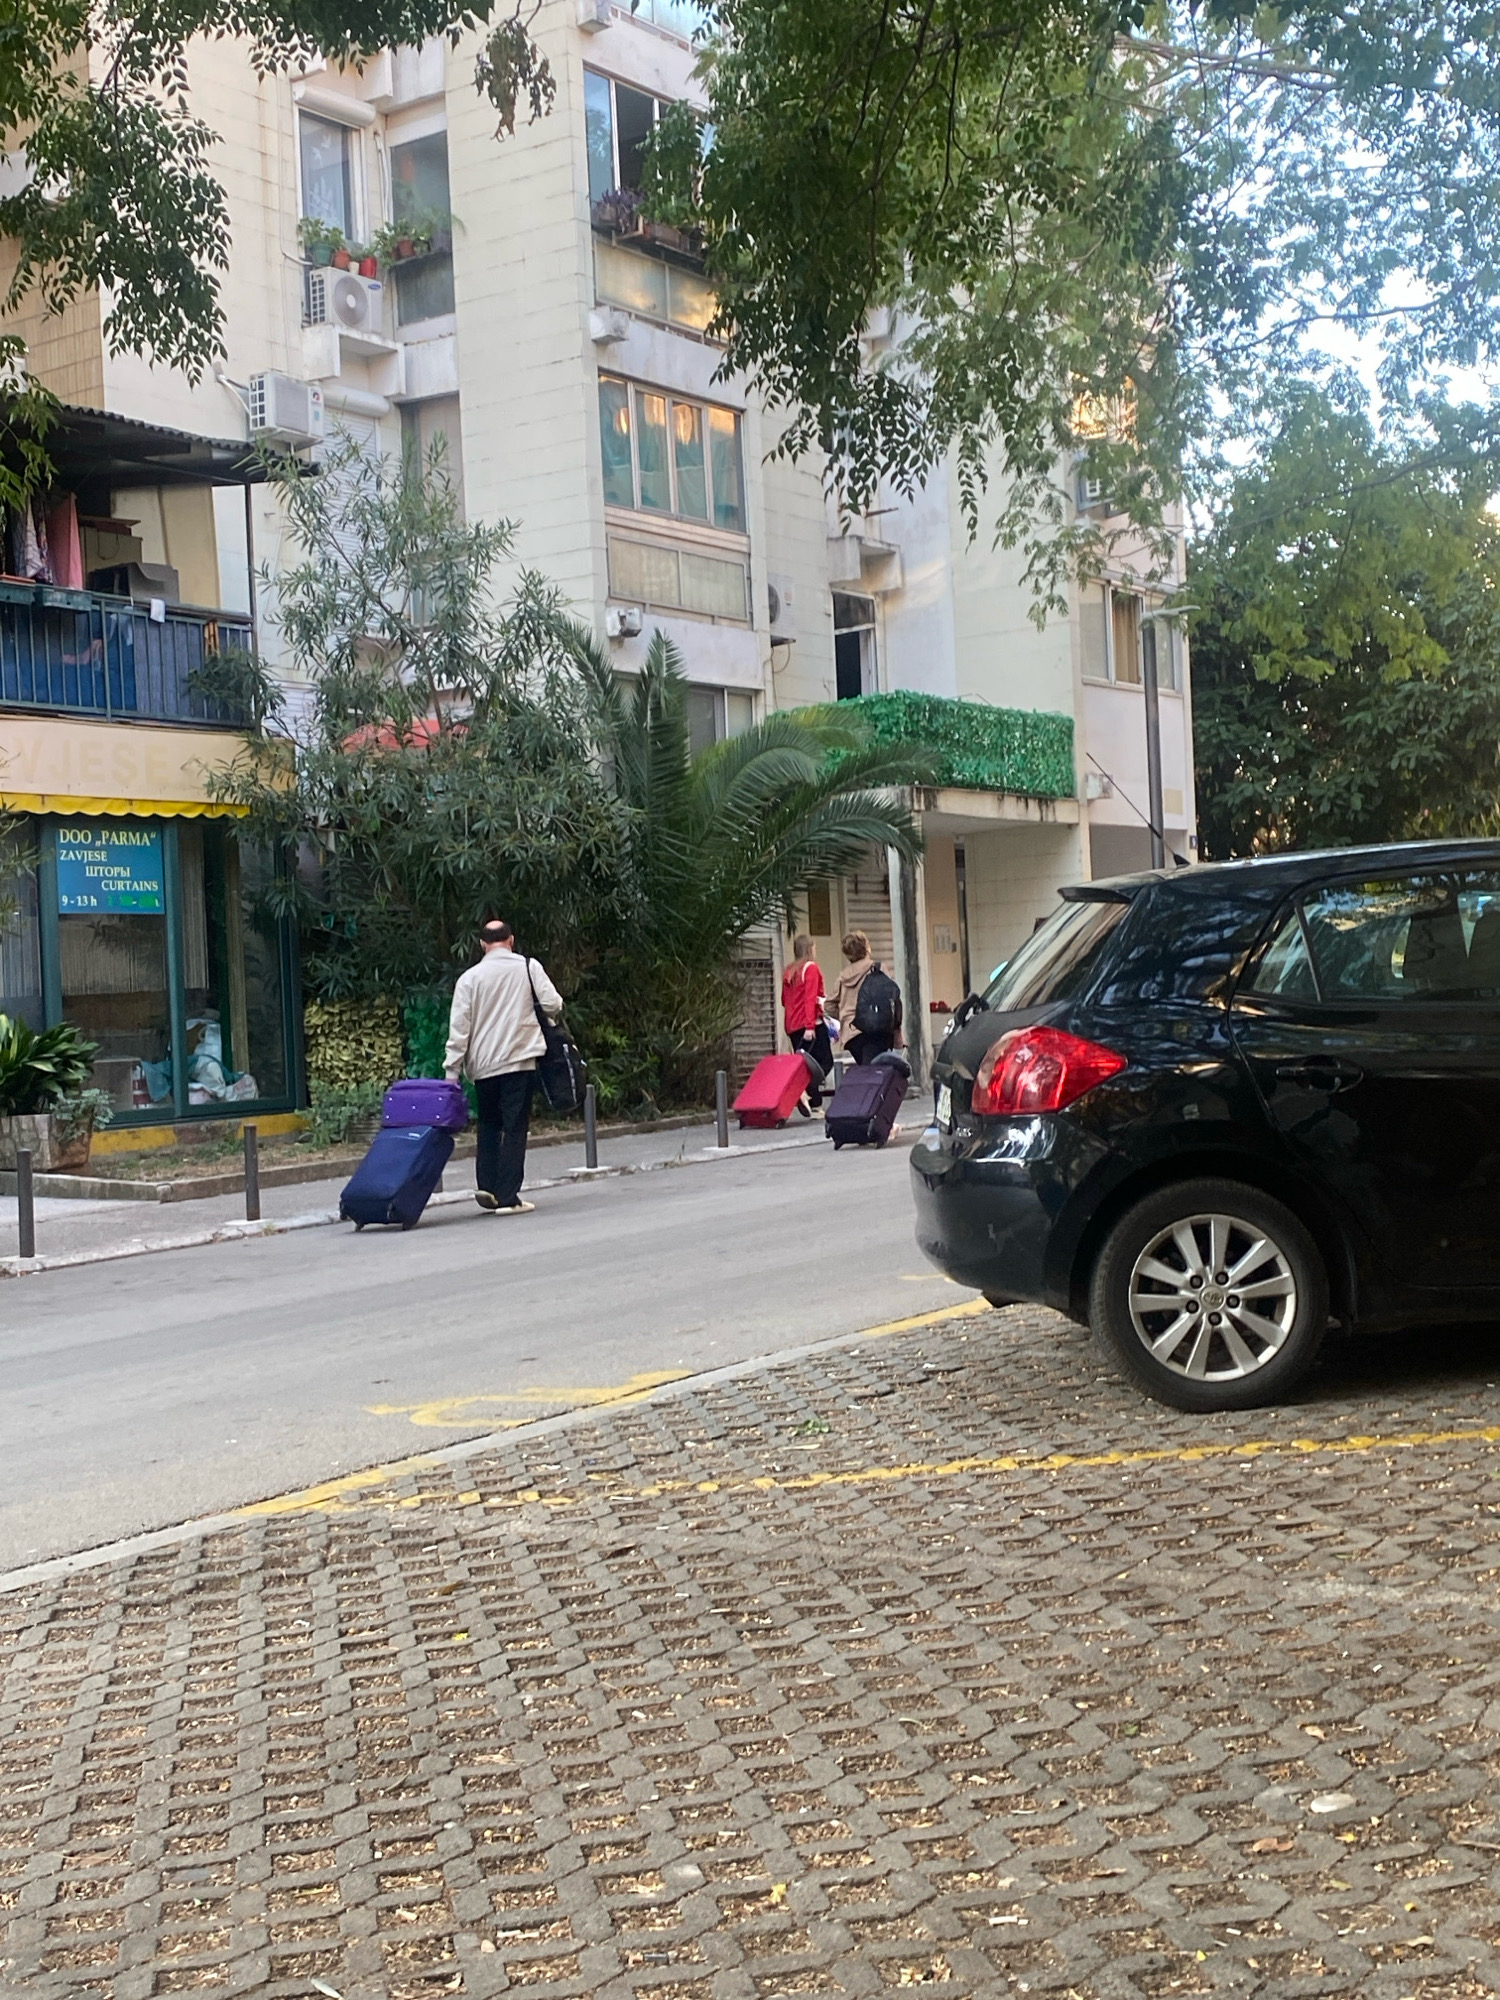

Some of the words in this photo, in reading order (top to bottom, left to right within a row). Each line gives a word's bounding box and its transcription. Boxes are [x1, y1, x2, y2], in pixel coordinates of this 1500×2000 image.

[59, 828, 92, 844] DOO
[60, 849, 107, 863] ZAVJESE
[85, 865, 130, 877] ШТОРЫ
[101, 880, 158, 891] CURTAINS
[76, 896, 88, 907] 13
